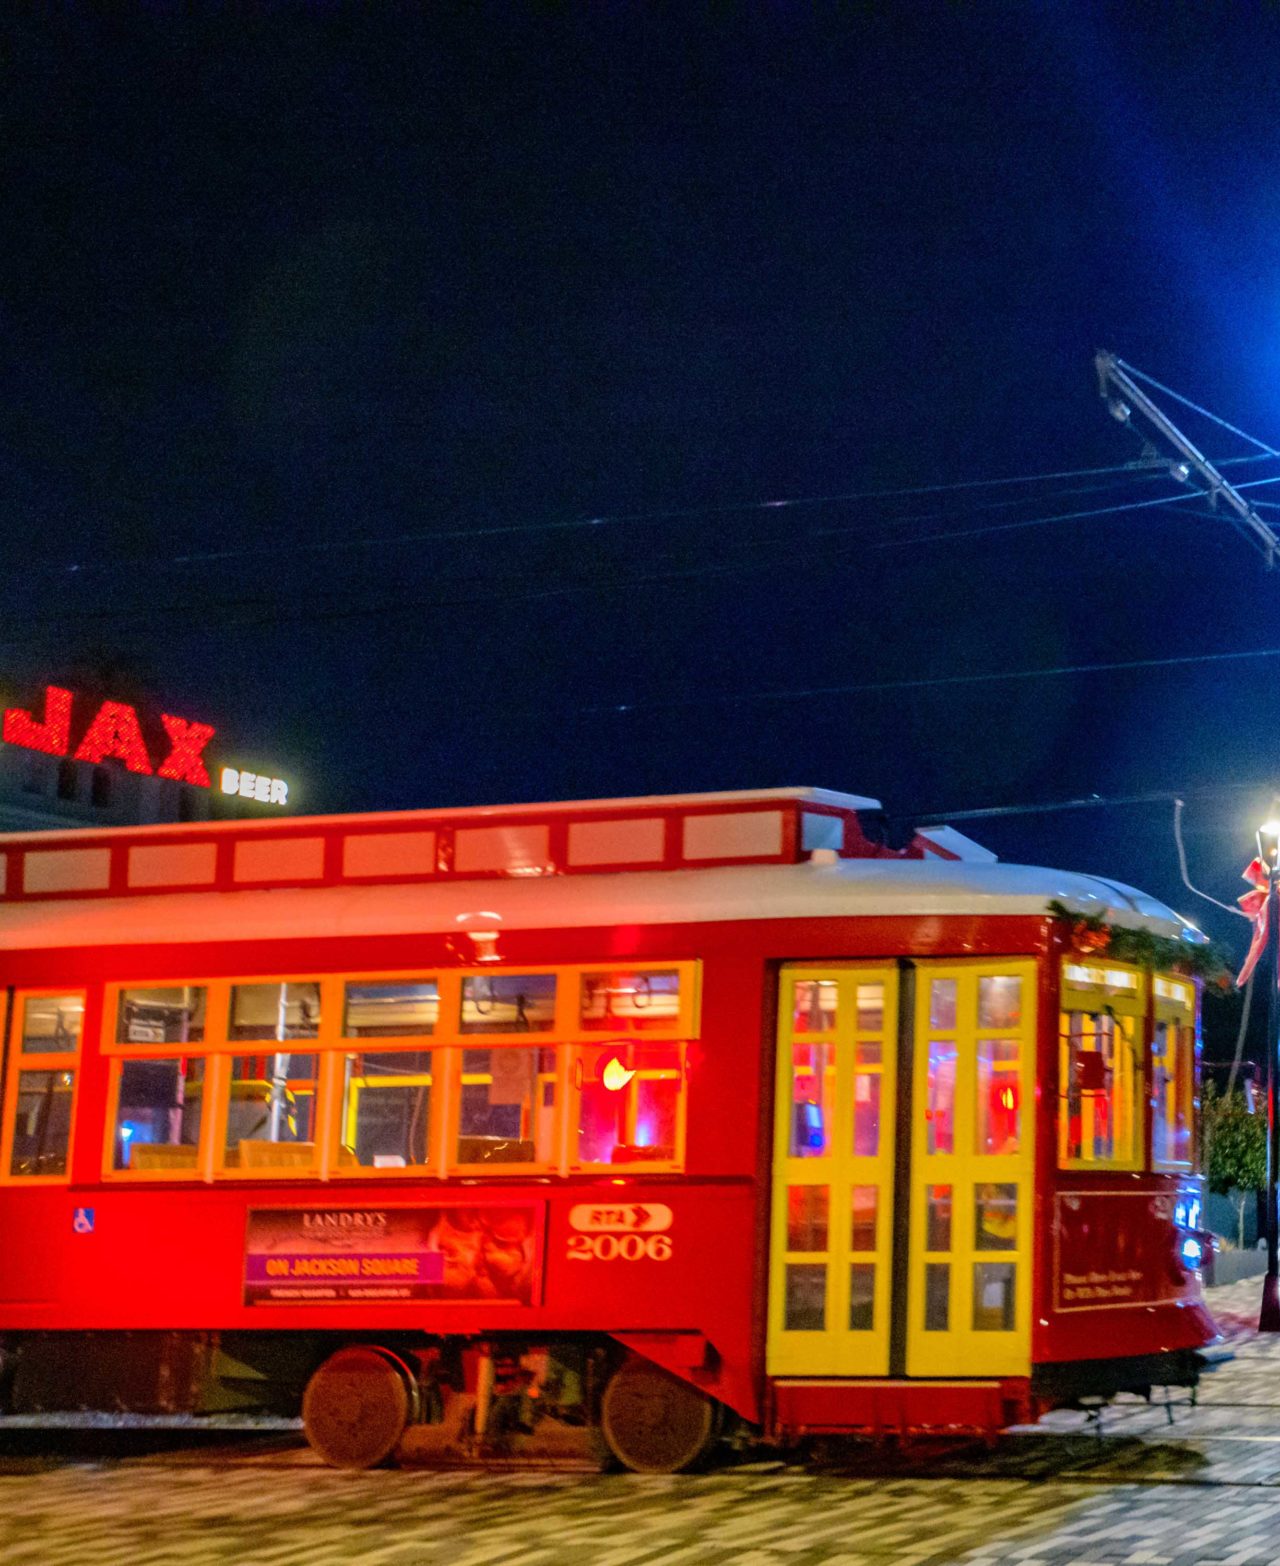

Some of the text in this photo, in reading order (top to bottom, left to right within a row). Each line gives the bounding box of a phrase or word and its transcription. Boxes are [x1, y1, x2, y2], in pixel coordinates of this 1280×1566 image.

[2, 685, 215, 788] JAX
[220, 766, 289, 805] BEER
[590, 1209, 625, 1225] RTA
[566, 1234, 673, 1261] 2006
[266, 1258, 419, 1276] ON JACKSON SQUARE
